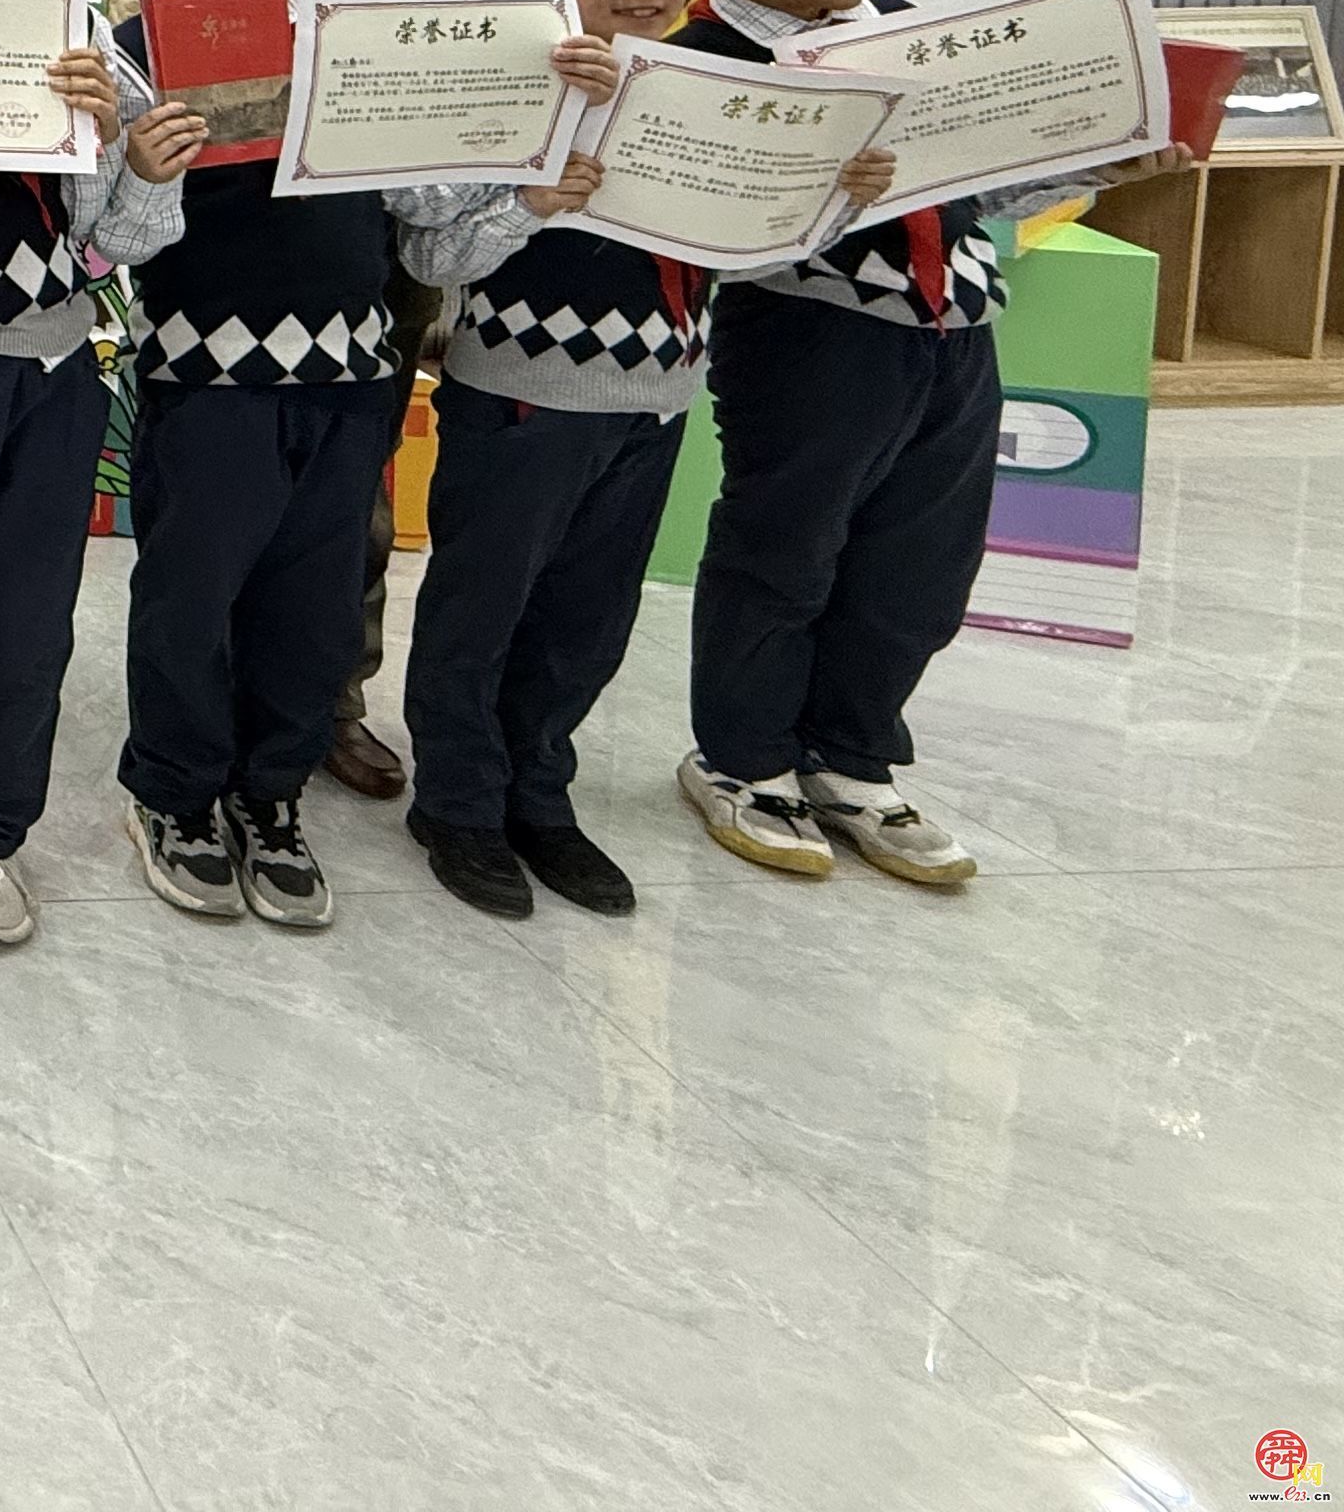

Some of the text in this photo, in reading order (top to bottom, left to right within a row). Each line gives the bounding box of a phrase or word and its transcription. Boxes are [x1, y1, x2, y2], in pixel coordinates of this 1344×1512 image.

[395, 14, 498, 45] 荣誉证书
[906, 17, 1027, 66] 荣誉证书
[720, 94, 831, 125] 荣誉证书
